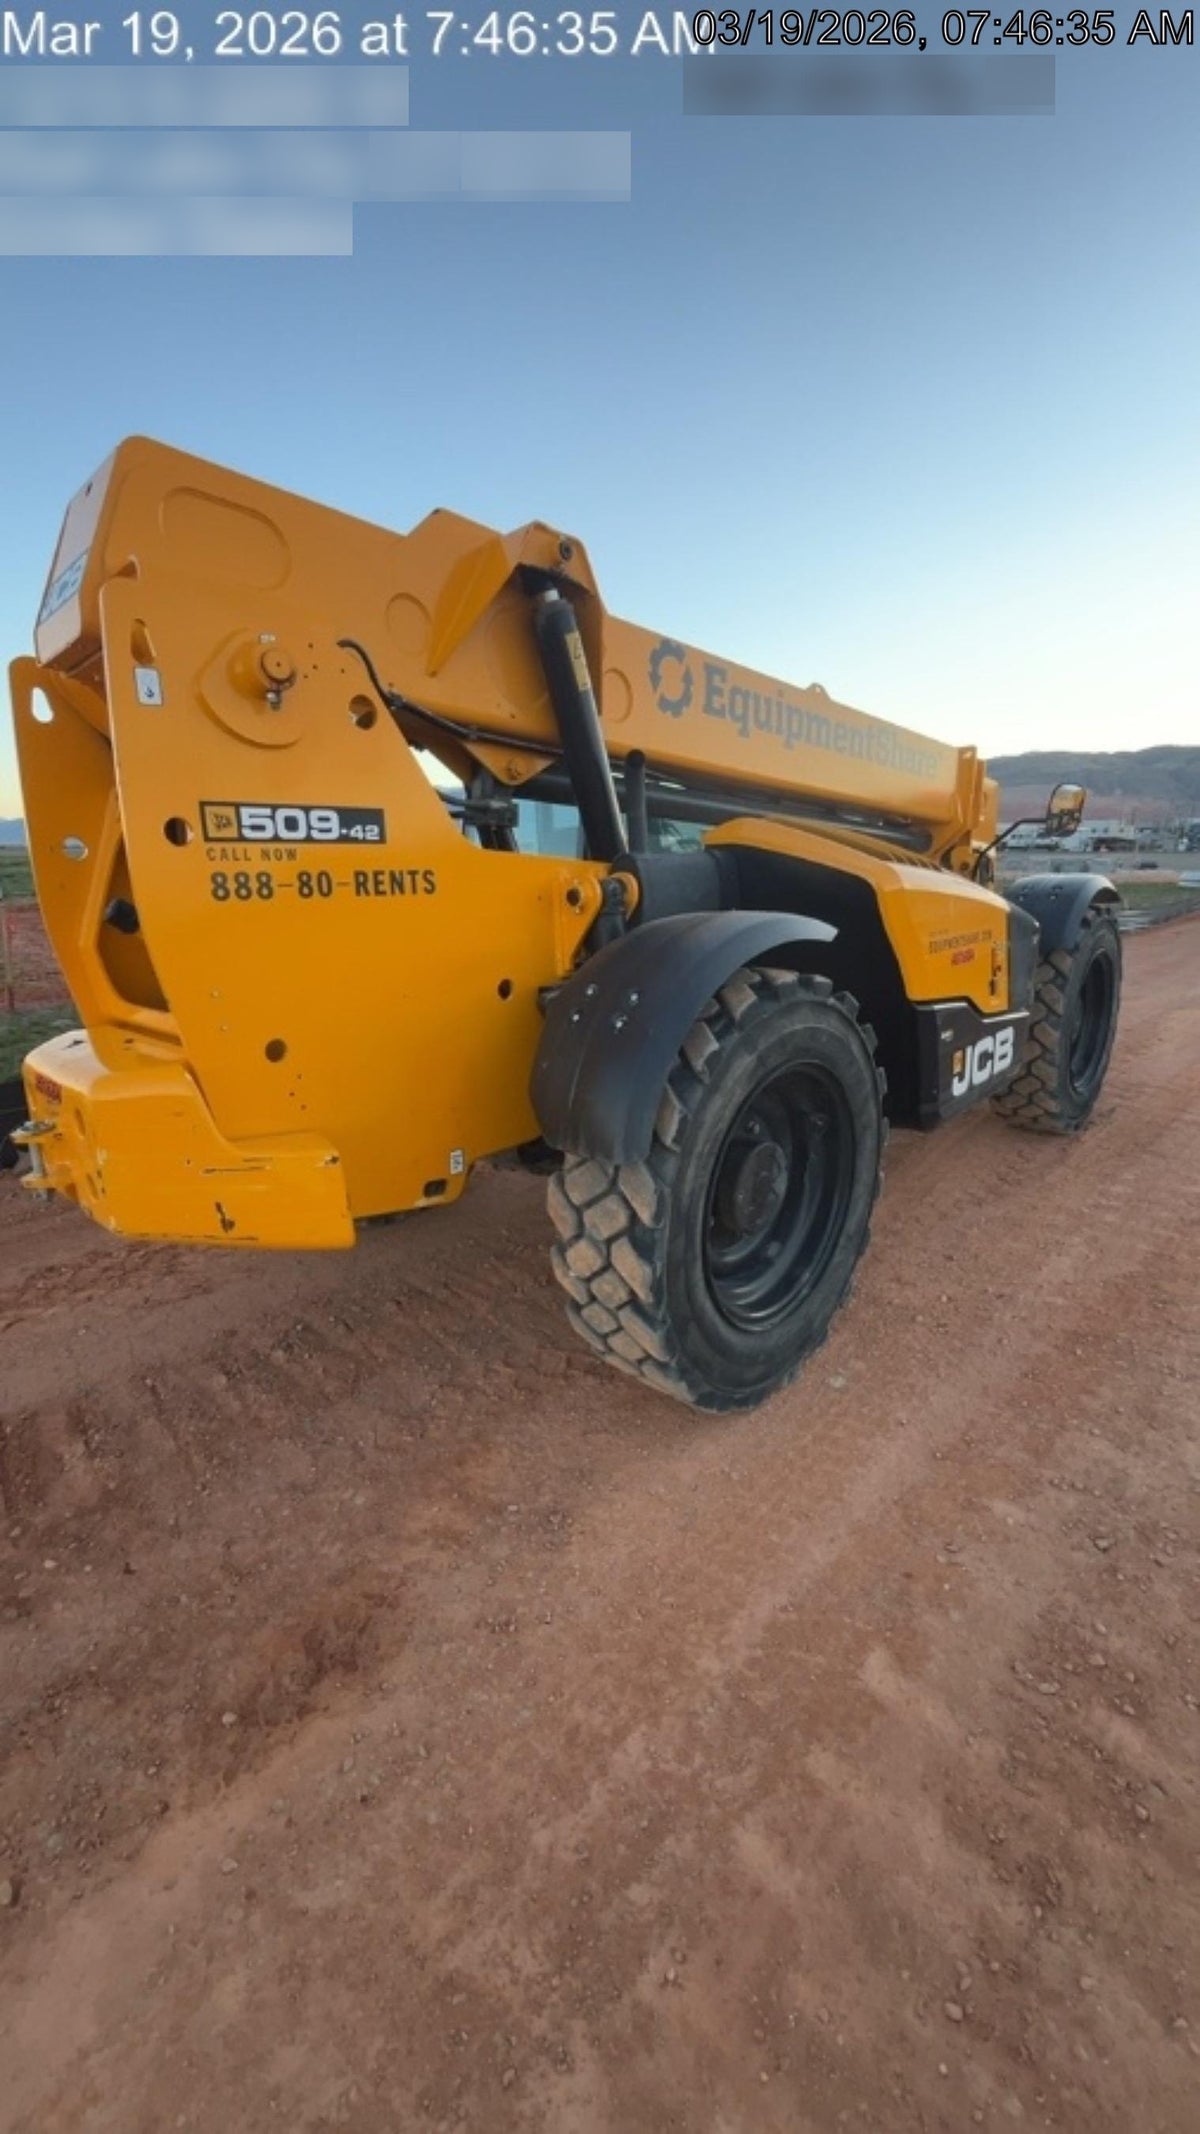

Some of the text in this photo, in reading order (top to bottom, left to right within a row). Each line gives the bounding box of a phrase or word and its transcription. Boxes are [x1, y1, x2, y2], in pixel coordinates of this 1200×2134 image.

[702, 661, 941, 778] EquipmentShare
[239, 806, 380, 840] 509-42
[205, 847, 299, 862] CALL NOW
[211, 869, 437, 901] 888-80-RENTS
[952, 1025, 1015, 1097] JCB
